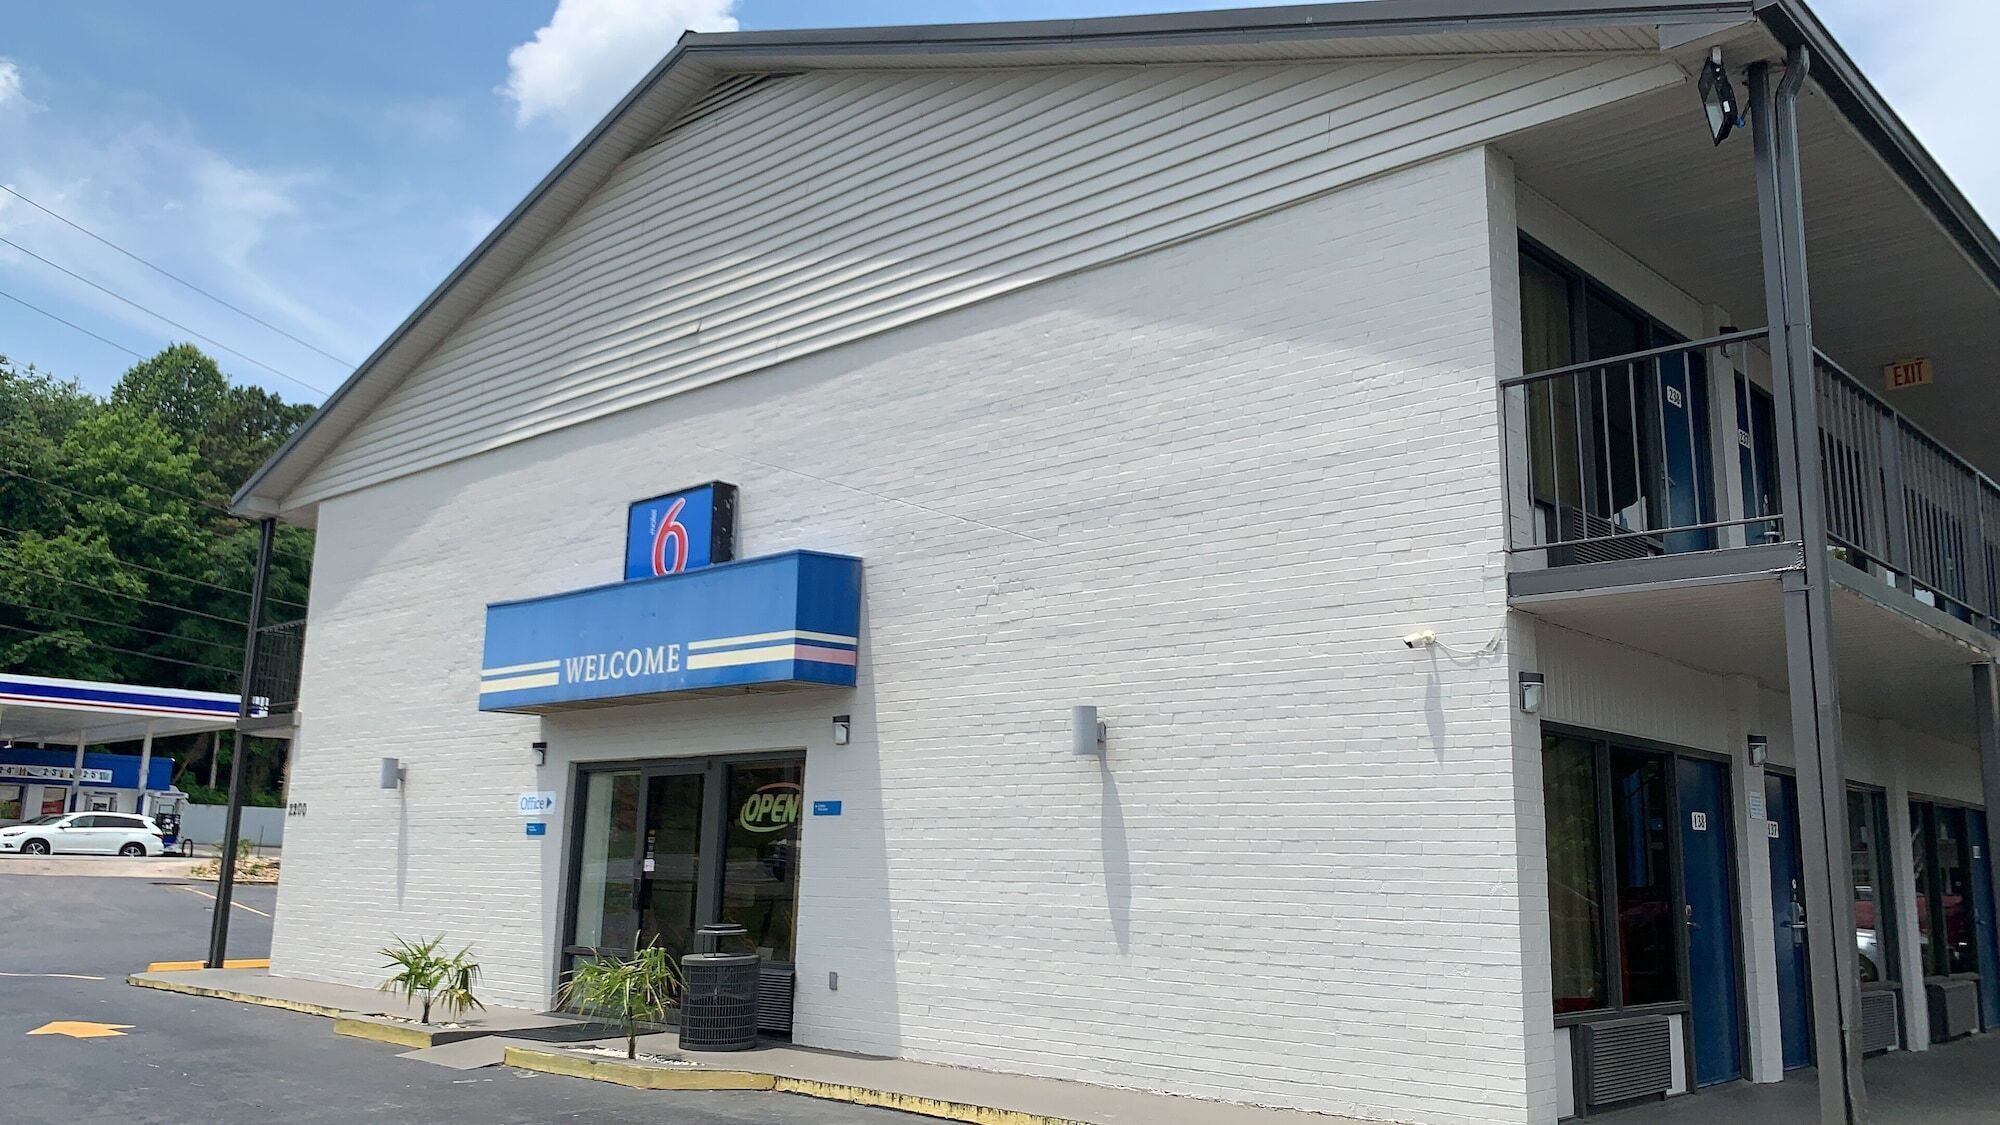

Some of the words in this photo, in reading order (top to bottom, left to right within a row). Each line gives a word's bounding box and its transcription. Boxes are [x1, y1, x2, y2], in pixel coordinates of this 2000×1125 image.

[1893, 361, 1923, 387] EXIT
[652, 497, 689, 577] 6
[565, 643, 681, 684] WELCOME
[288, 802, 307, 816] 2200
[521, 796, 545, 810] Office
[744, 793, 801, 823] OPEN
[1694, 814, 1705, 828] 138
